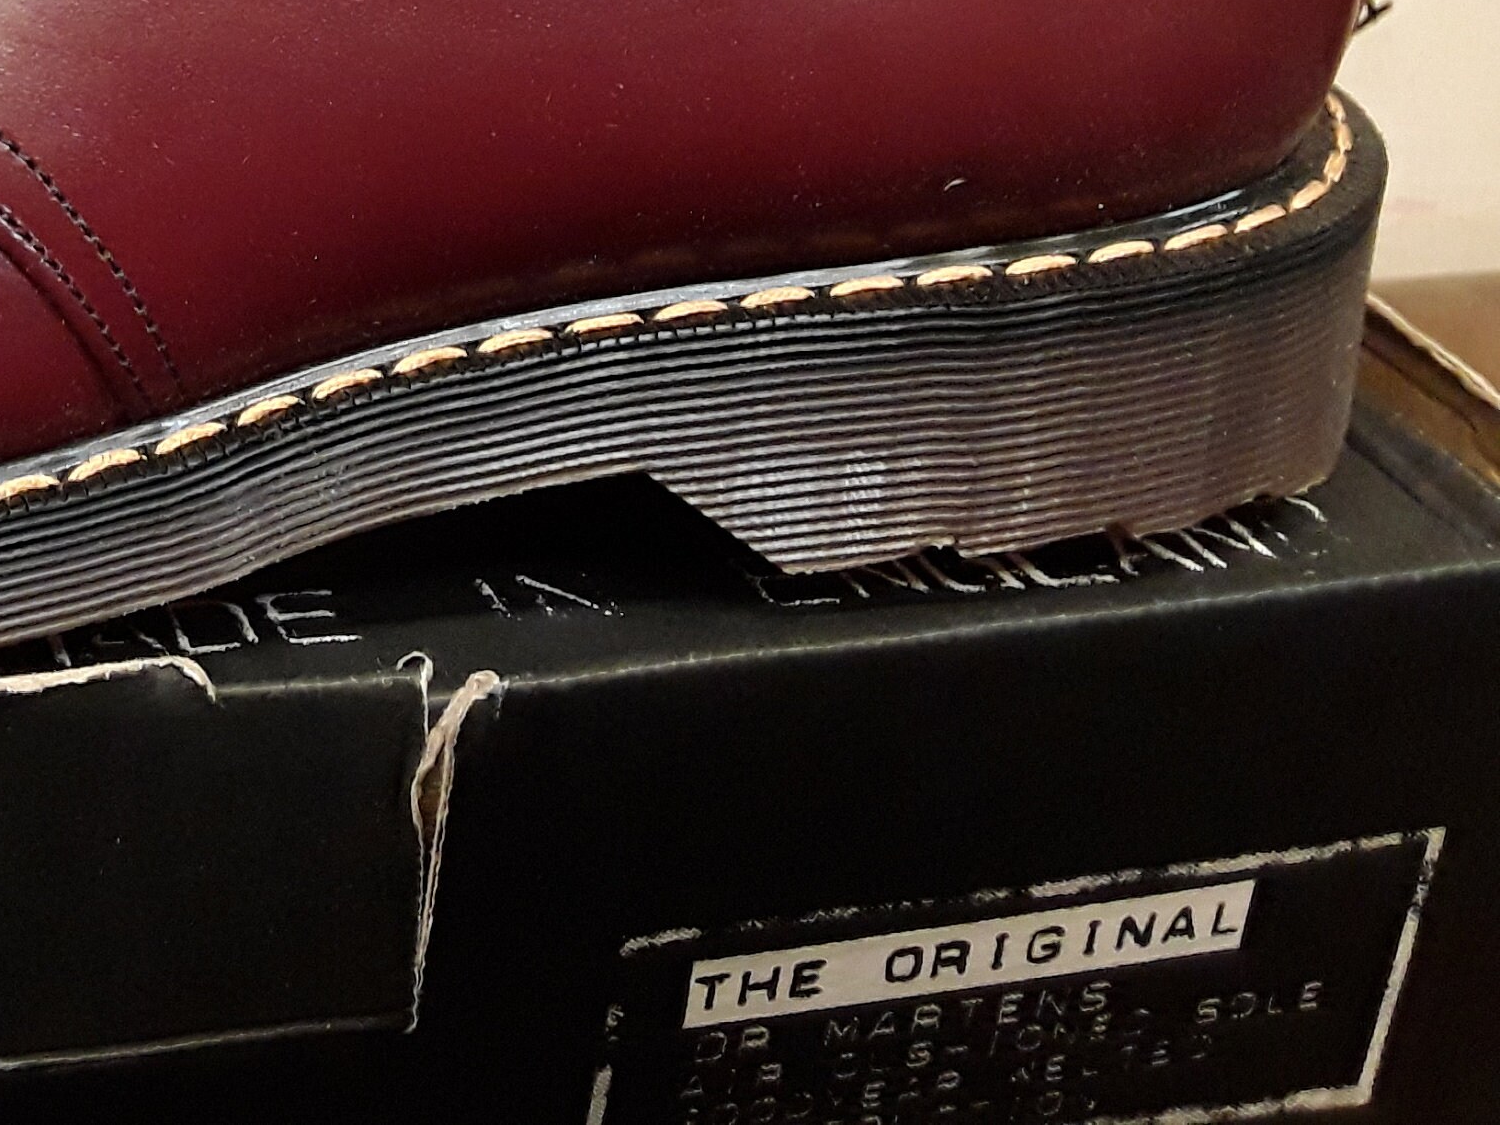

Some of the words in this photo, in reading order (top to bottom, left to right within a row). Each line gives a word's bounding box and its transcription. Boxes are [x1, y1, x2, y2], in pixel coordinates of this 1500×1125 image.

[692, 958, 830, 1012] THE
[883, 900, 1240, 985] ORIGINAL
[823, 979, 1114, 1046] MARTENS
[1194, 979, 1325, 1025] SOLE
